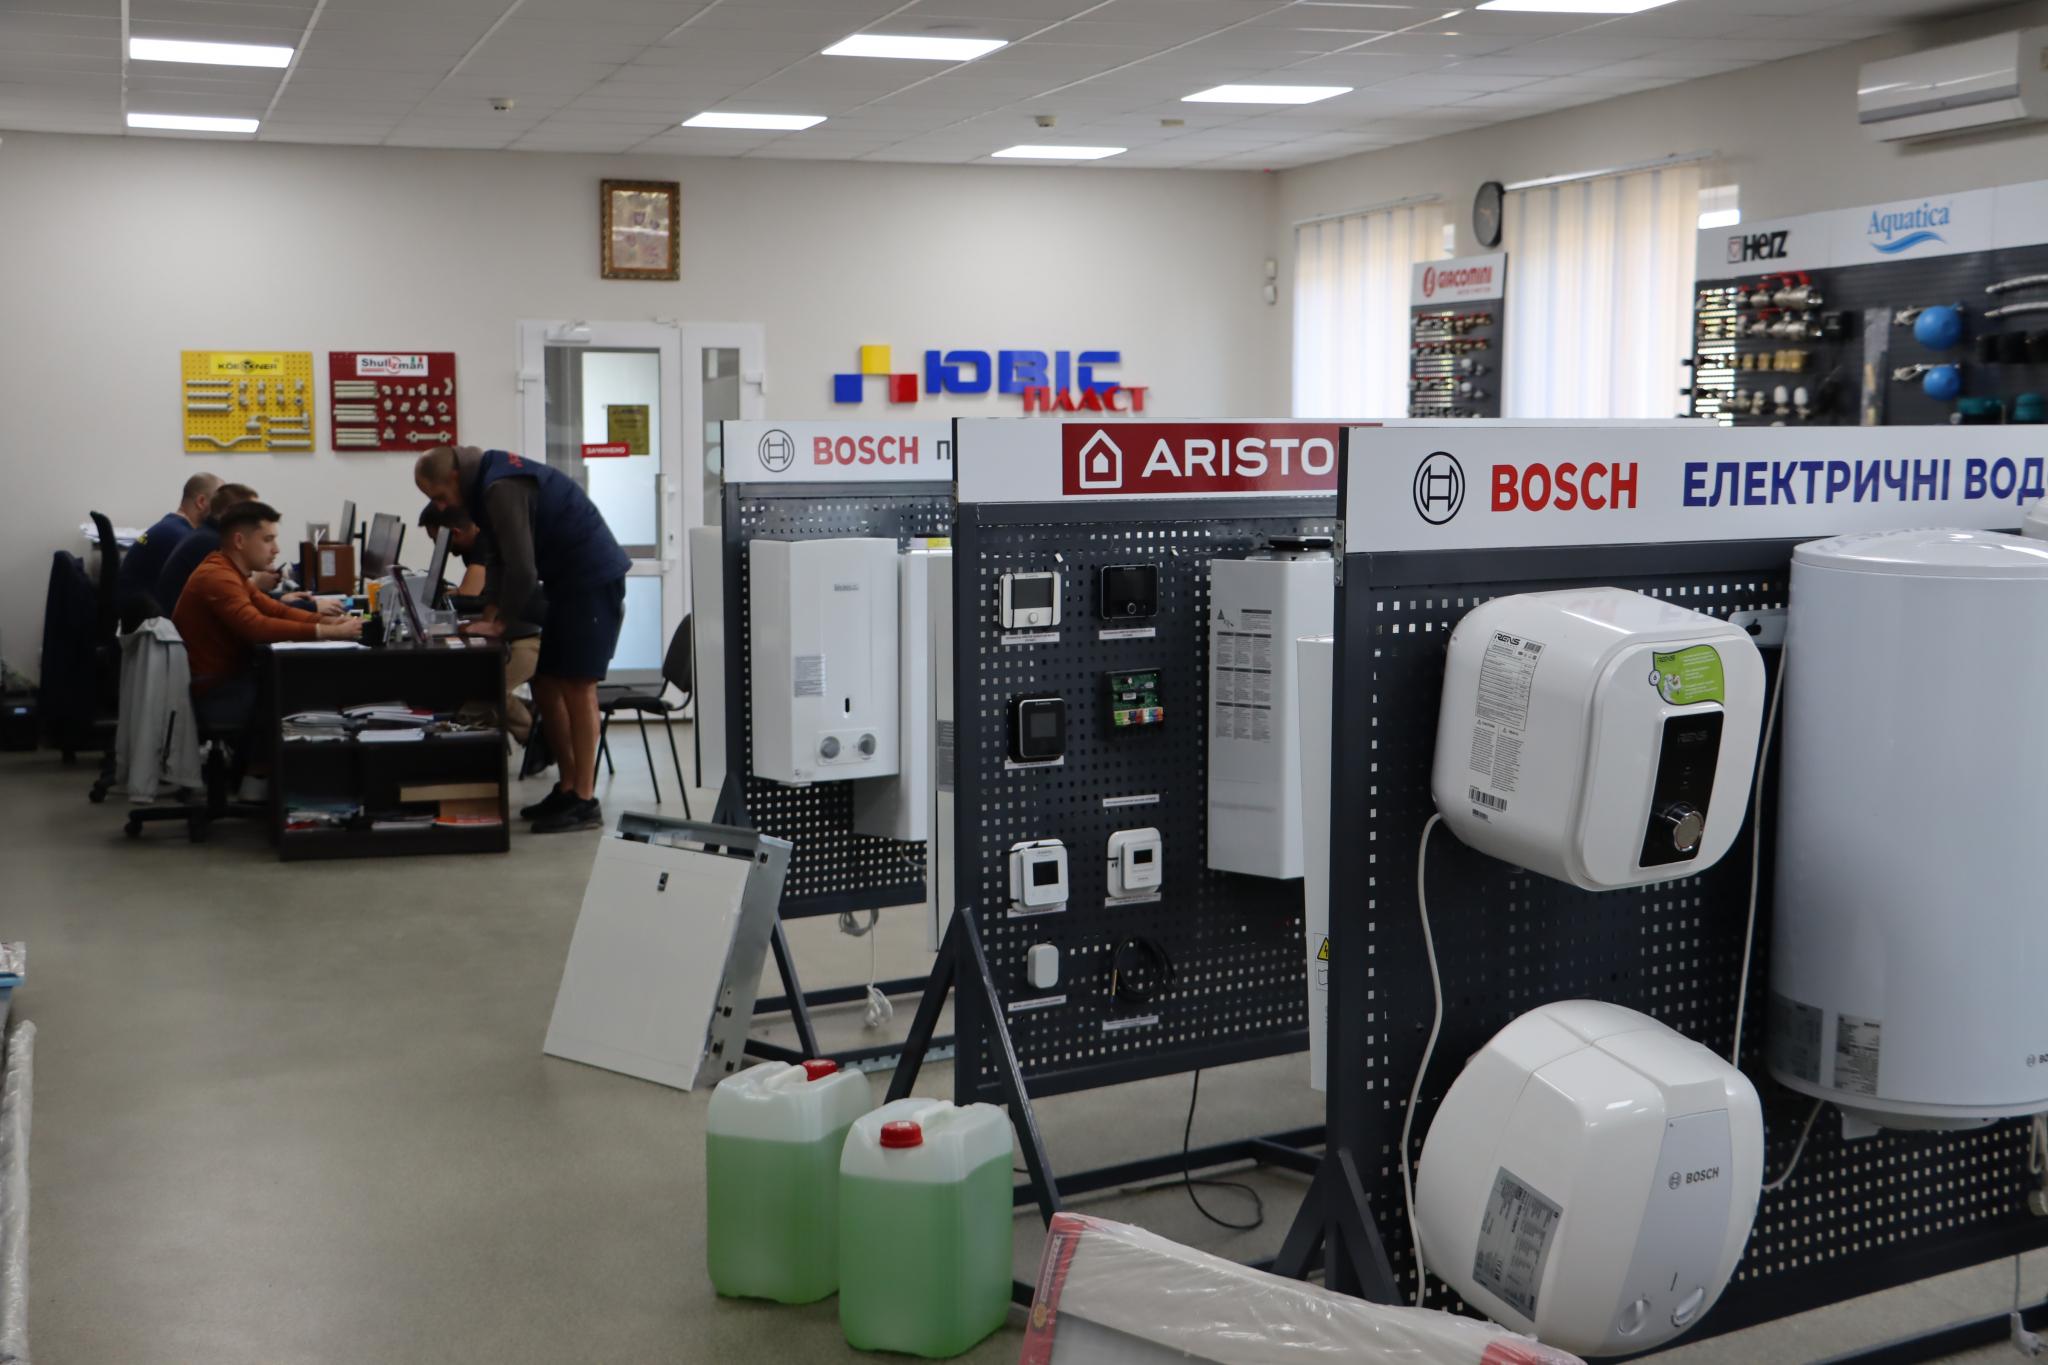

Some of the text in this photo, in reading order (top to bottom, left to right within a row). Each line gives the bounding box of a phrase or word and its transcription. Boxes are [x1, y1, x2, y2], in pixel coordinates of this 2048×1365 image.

[1867, 203, 1951, 241] Aquatica
[1438, 266, 1493, 288] GIACOMINI
[925, 350, 1120, 395] ЮВІС
[1023, 386, 1148, 413] ПЛАСТ
[813, 436, 919, 465] BOSCH
[1141, 437, 1335, 477] ARISTO
[1491, 457, 2048, 513] BOSCH ЕЛЕКТРИЧНІ ВОД
[1685, 1167, 1720, 1185] BOSCH
